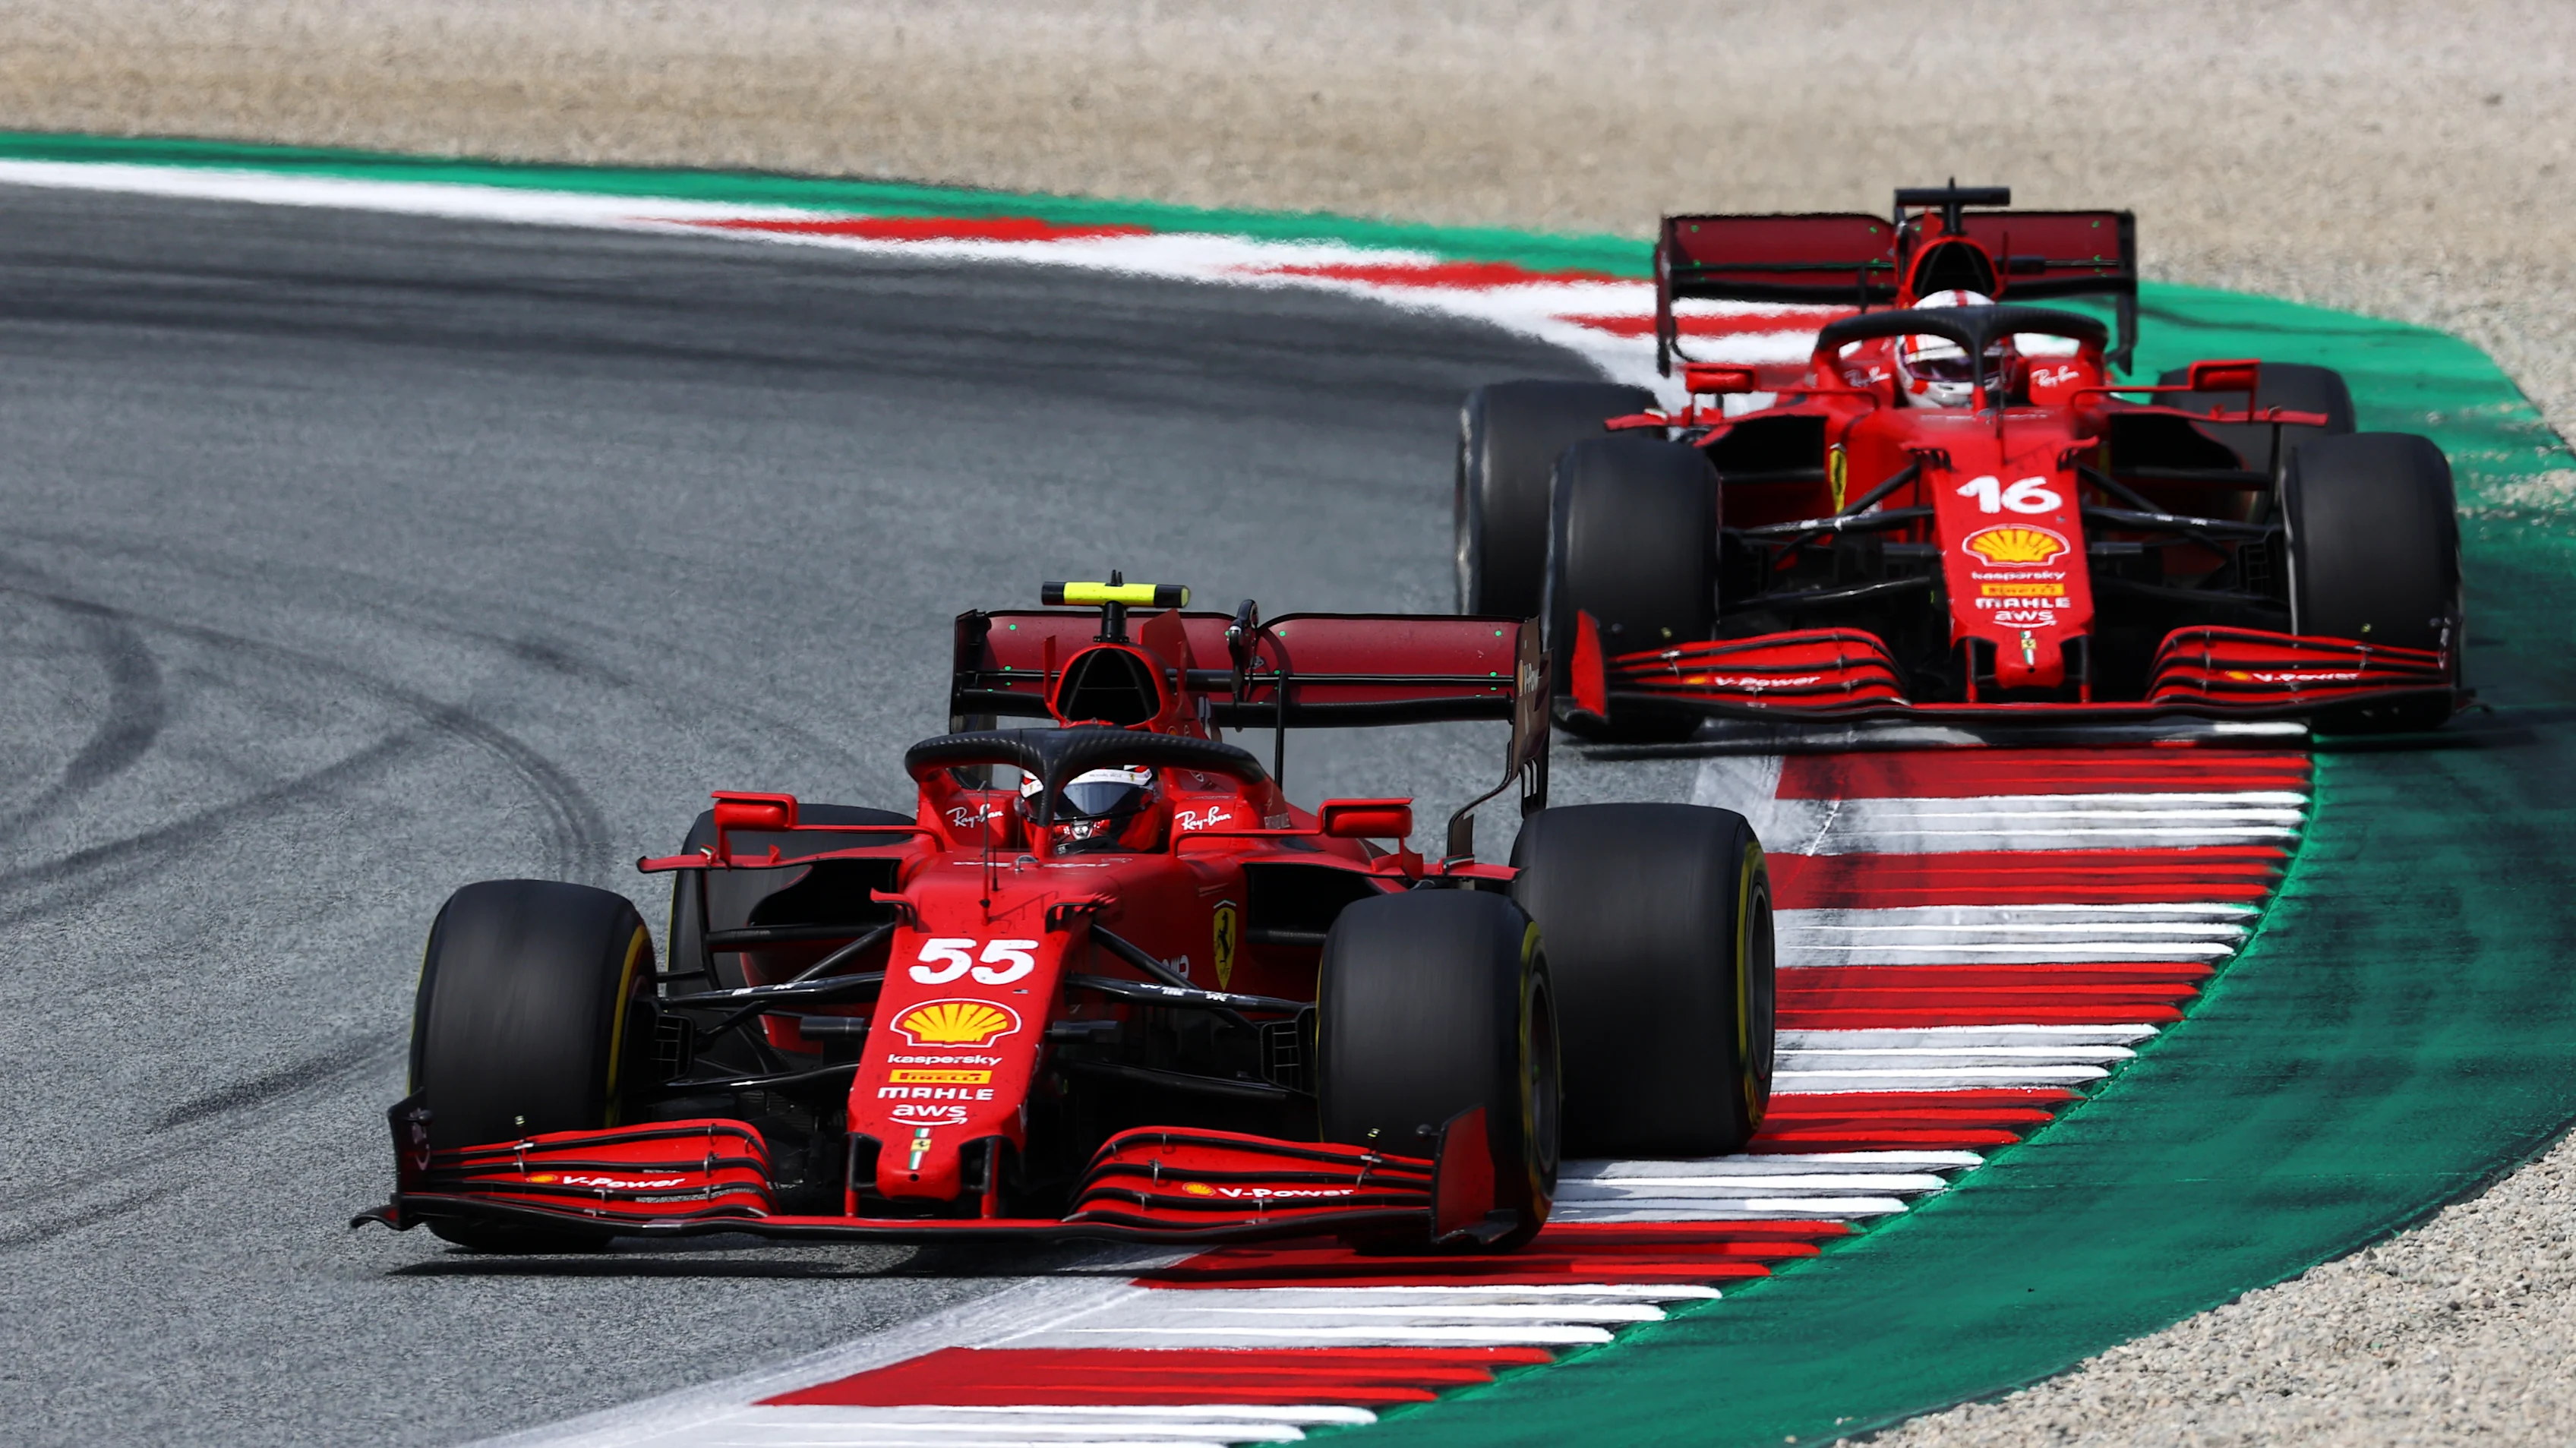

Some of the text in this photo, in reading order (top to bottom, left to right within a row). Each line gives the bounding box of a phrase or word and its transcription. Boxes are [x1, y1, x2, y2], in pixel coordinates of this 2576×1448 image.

[1956, 475, 2063, 514] 16
[1971, 571, 2066, 581] kaspersky
[1975, 597, 2071, 609] MAHLE
[1994, 610, 2054, 621] aws
[945, 803, 1004, 828] Ray-Ban
[1175, 806, 1232, 830] Ray-Ban
[908, 938, 1039, 985] 55
[887, 1054, 1002, 1066] kaspersky
[877, 1087, 995, 1100] MAHLE
[892, 1103, 967, 1117] aws
[563, 1175, 686, 1188] V-Power
[1217, 1188, 1354, 1197] V-Power
